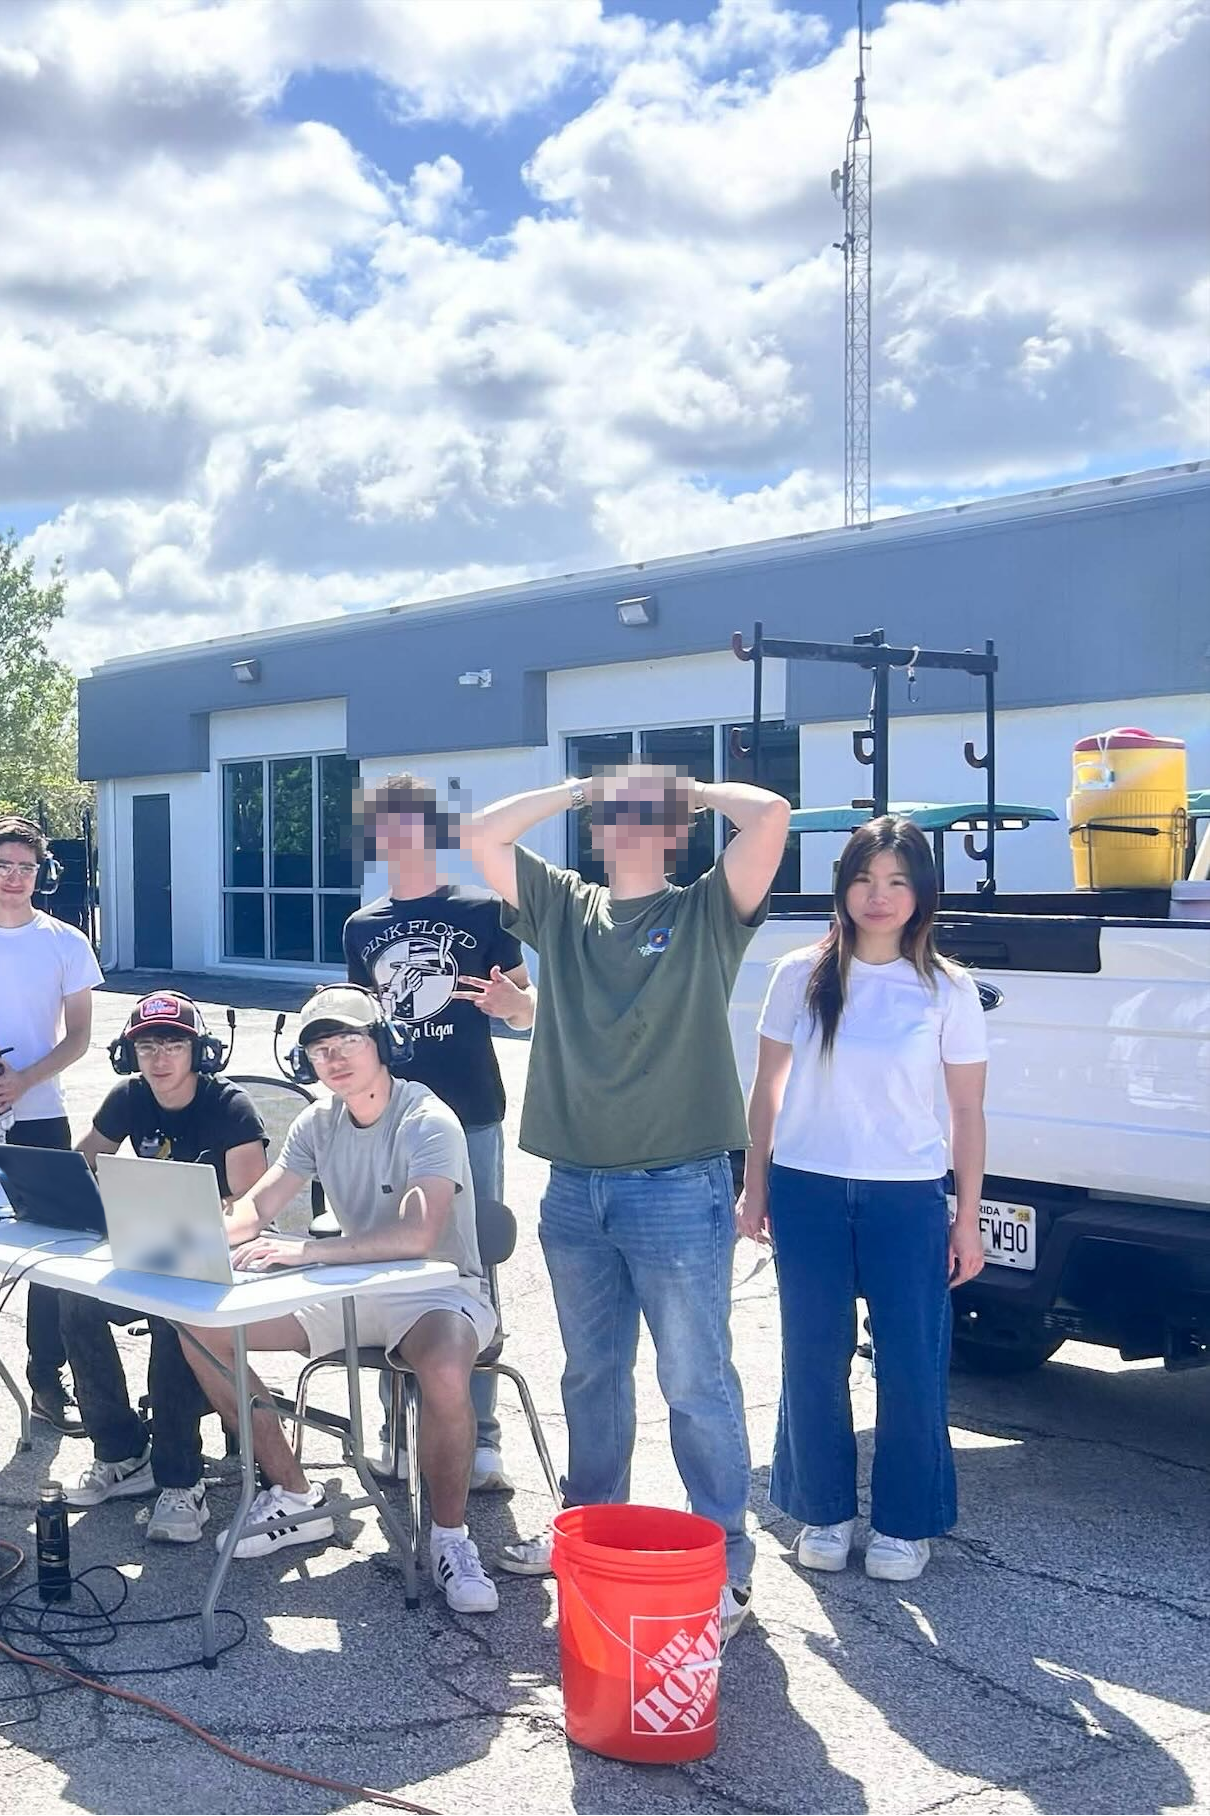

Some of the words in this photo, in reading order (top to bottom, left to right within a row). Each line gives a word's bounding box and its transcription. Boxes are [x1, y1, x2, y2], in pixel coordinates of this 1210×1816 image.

[361, 922, 405, 962] PINK
[407, 920, 477, 949] FLOYD
[424, 1021, 454, 1041] Cigar
[979, 1204, 1000, 1216] RIDA
[979, 1217, 1027, 1254] FW90
[645, 1628, 694, 1677] THE
[679, 1670, 718, 1730] DEP
